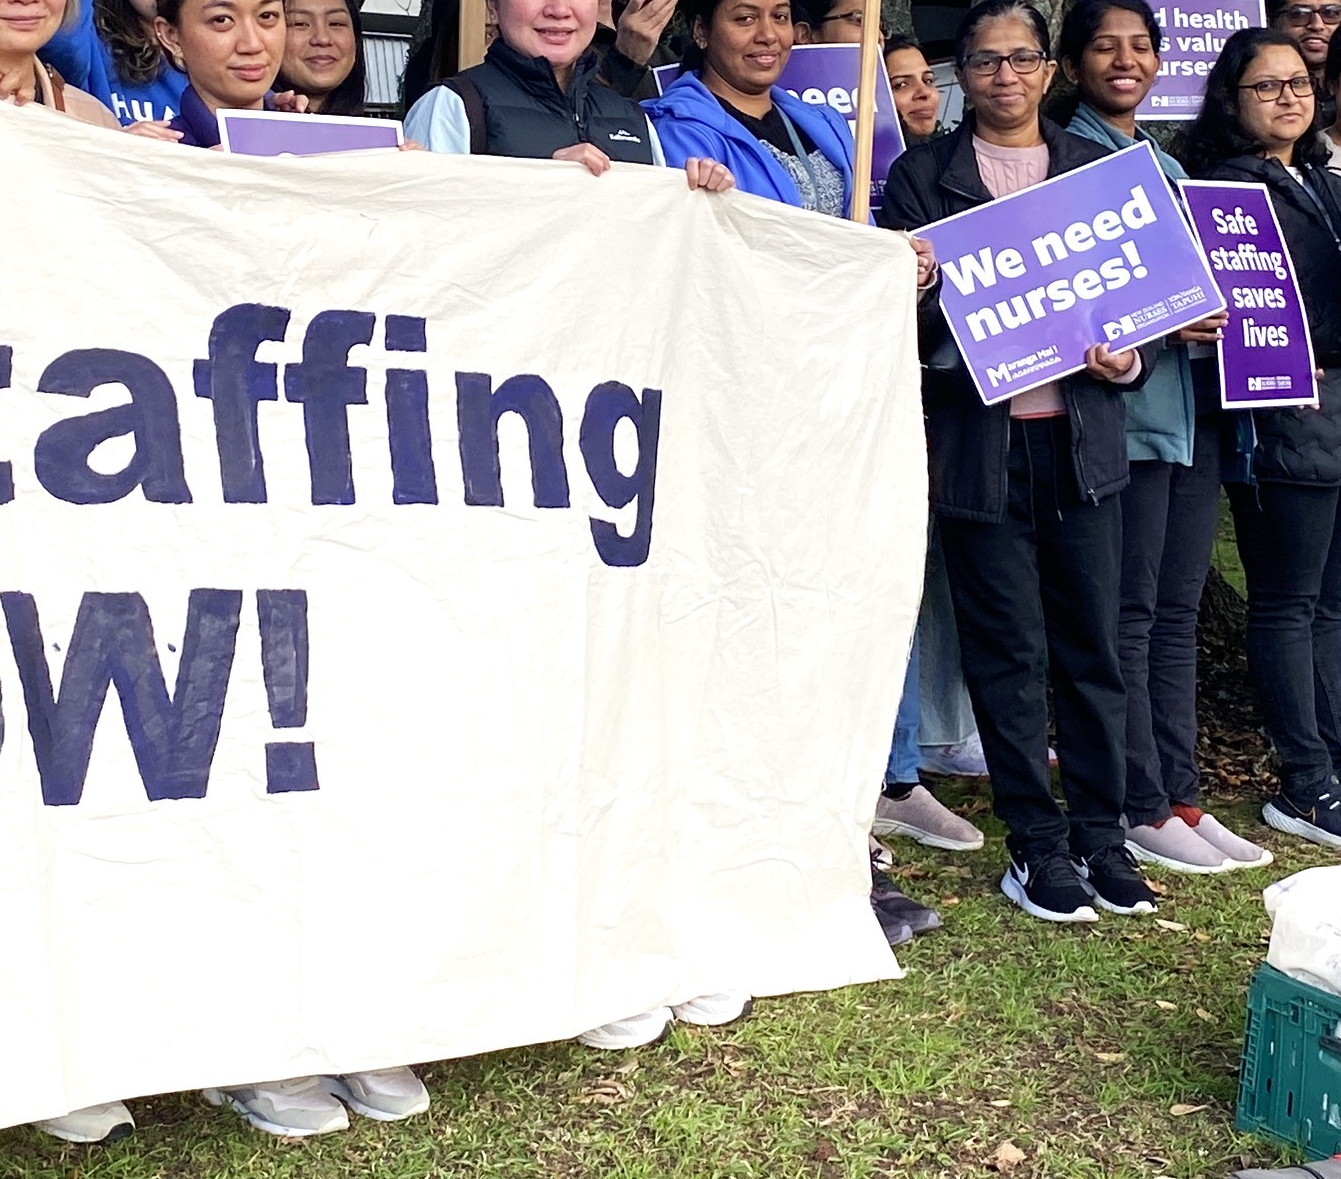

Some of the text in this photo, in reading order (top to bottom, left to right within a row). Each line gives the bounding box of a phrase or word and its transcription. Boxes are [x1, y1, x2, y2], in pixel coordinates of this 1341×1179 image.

[1173, 7, 1249, 30] health
[1176, 33, 1223, 52] valu
[1156, 61, 1216, 77] urse
[786, 87, 879, 114] ee
[1212, 206, 1258, 236] Safe
[940, 184, 1157, 296] We need
[1210, 244, 1287, 280] staffing
[965, 240, 1148, 342] nurses!
[1232, 286, 1286, 309] saves
[1243, 318, 1289, 348] lives
